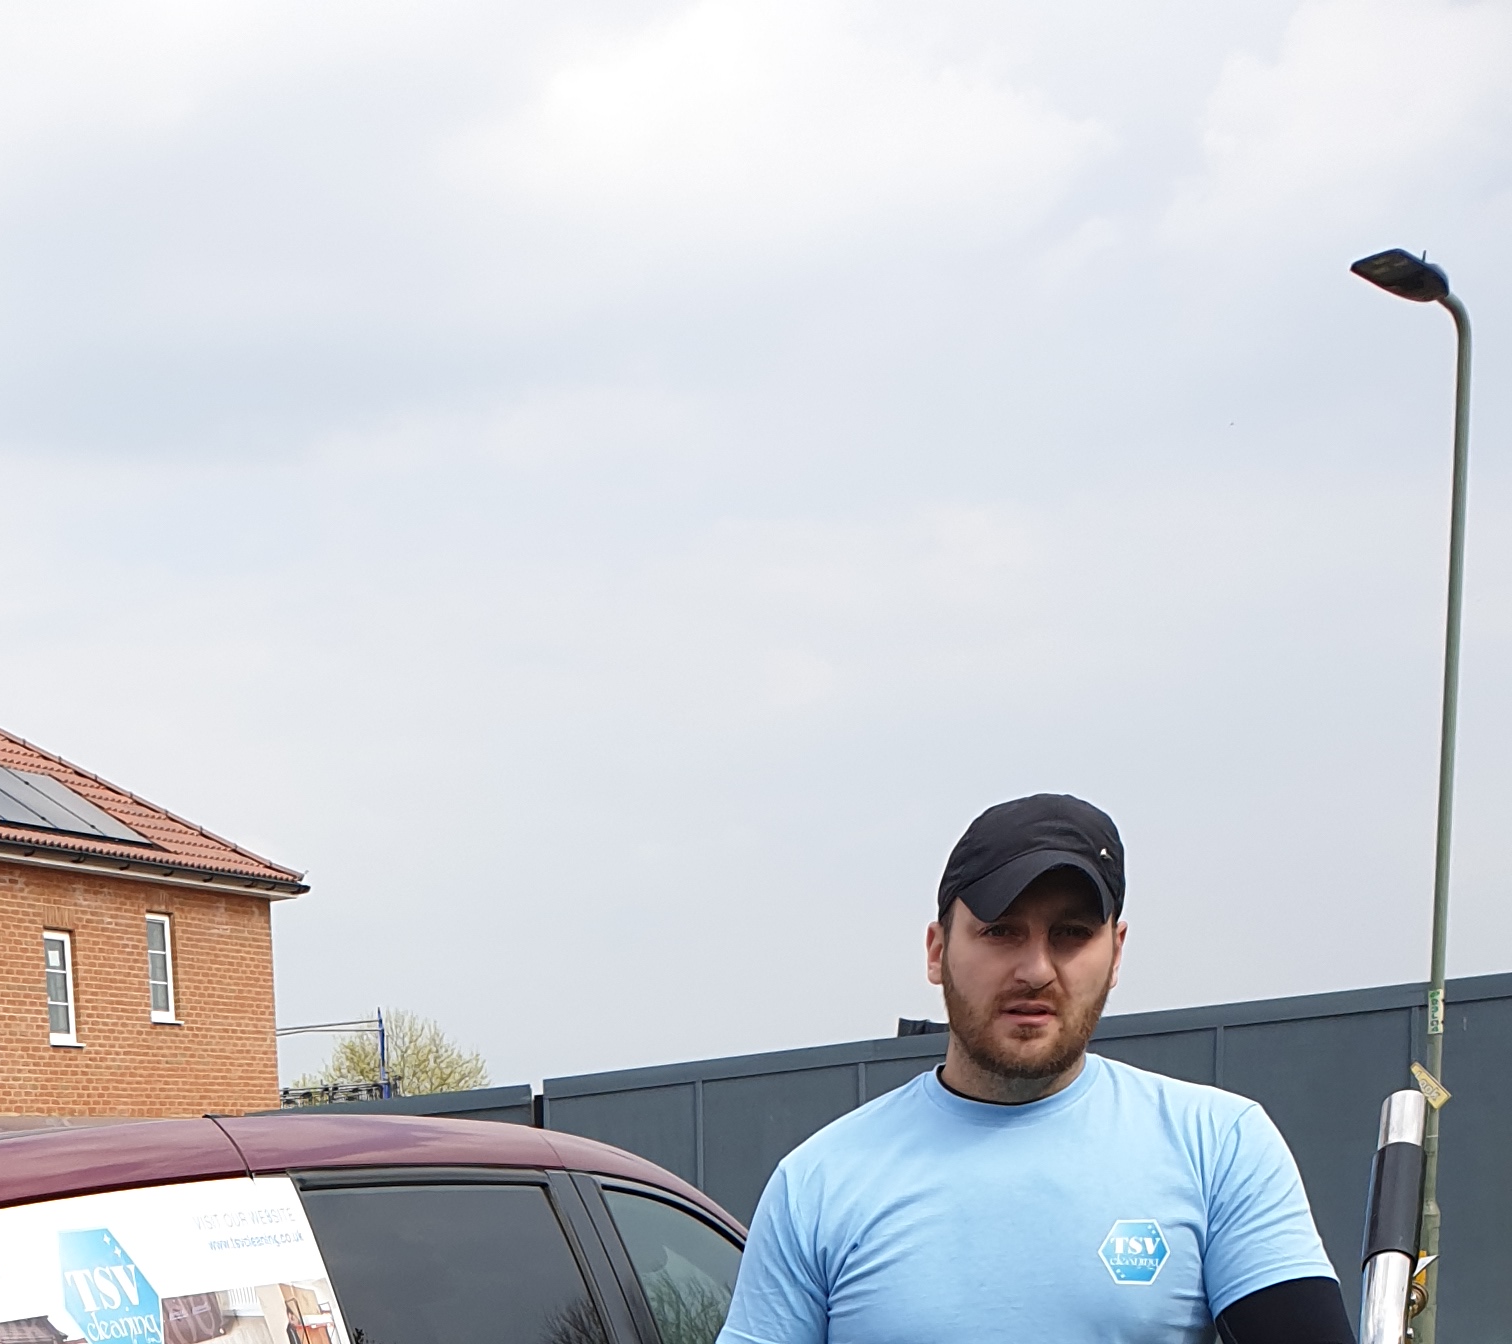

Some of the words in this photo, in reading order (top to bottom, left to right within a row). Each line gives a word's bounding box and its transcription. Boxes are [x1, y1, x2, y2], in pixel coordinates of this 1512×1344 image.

[248, 1207, 296, 1225] WEBSITE
[1110, 1236, 1161, 1255] TSV
[64, 1264, 140, 1312] TSV
[87, 1306, 162, 1343] cleaning
